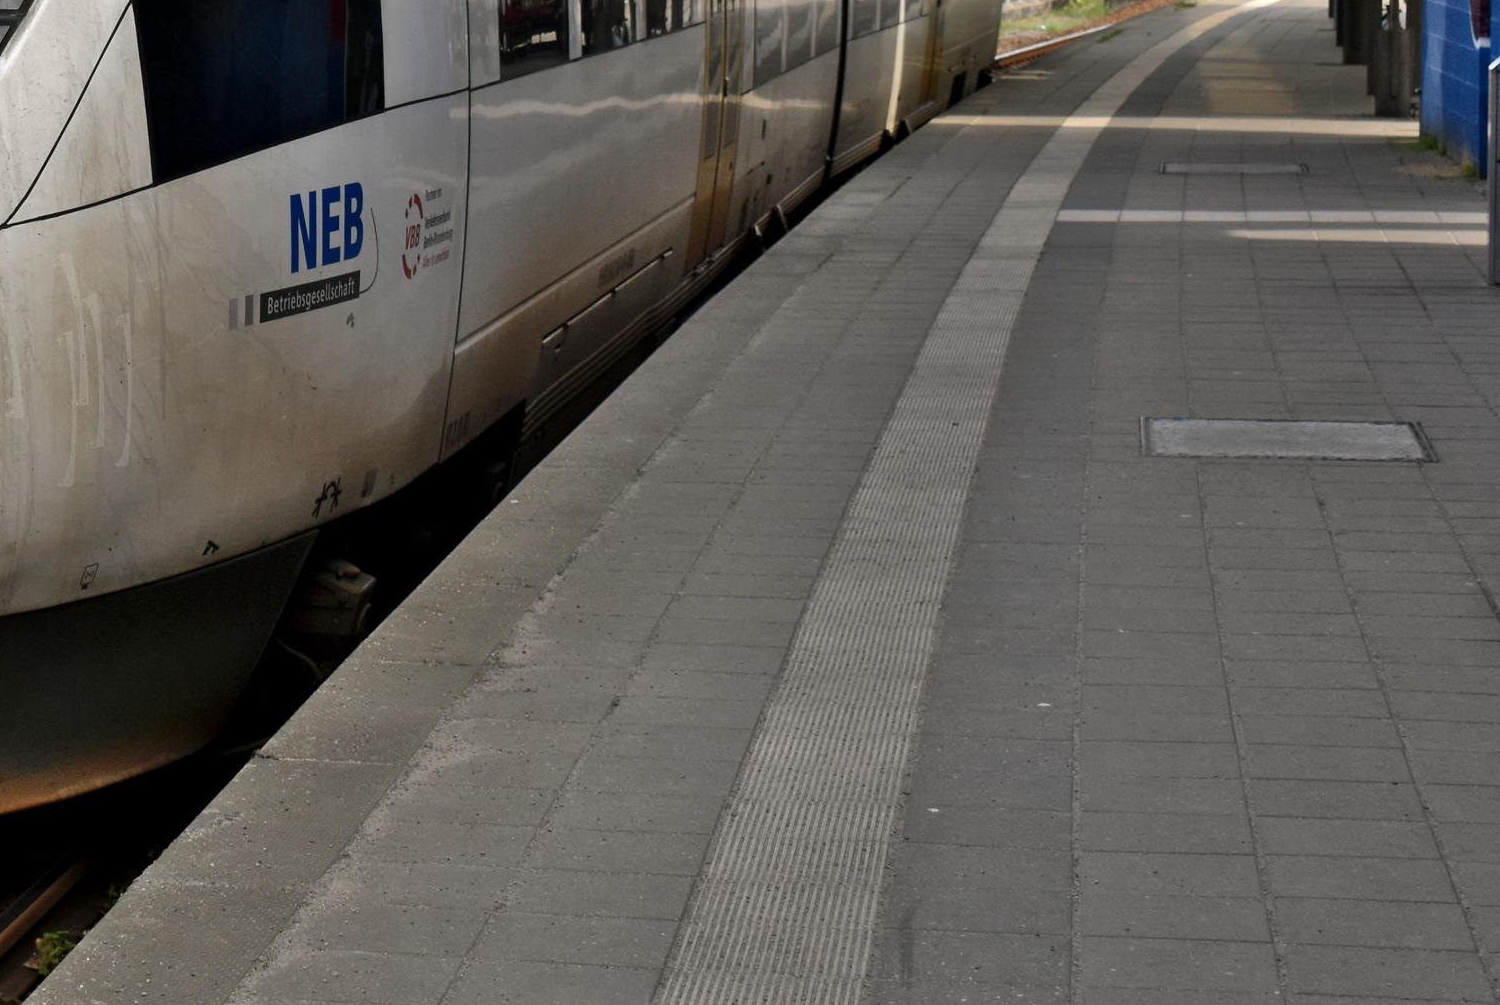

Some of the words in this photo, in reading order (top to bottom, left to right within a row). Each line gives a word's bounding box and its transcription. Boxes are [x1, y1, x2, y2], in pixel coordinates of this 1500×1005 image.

[289, 181, 364, 274] NEB
[405, 223, 422, 251] VBB
[267, 278, 355, 315] Betriebsgesellschaft
